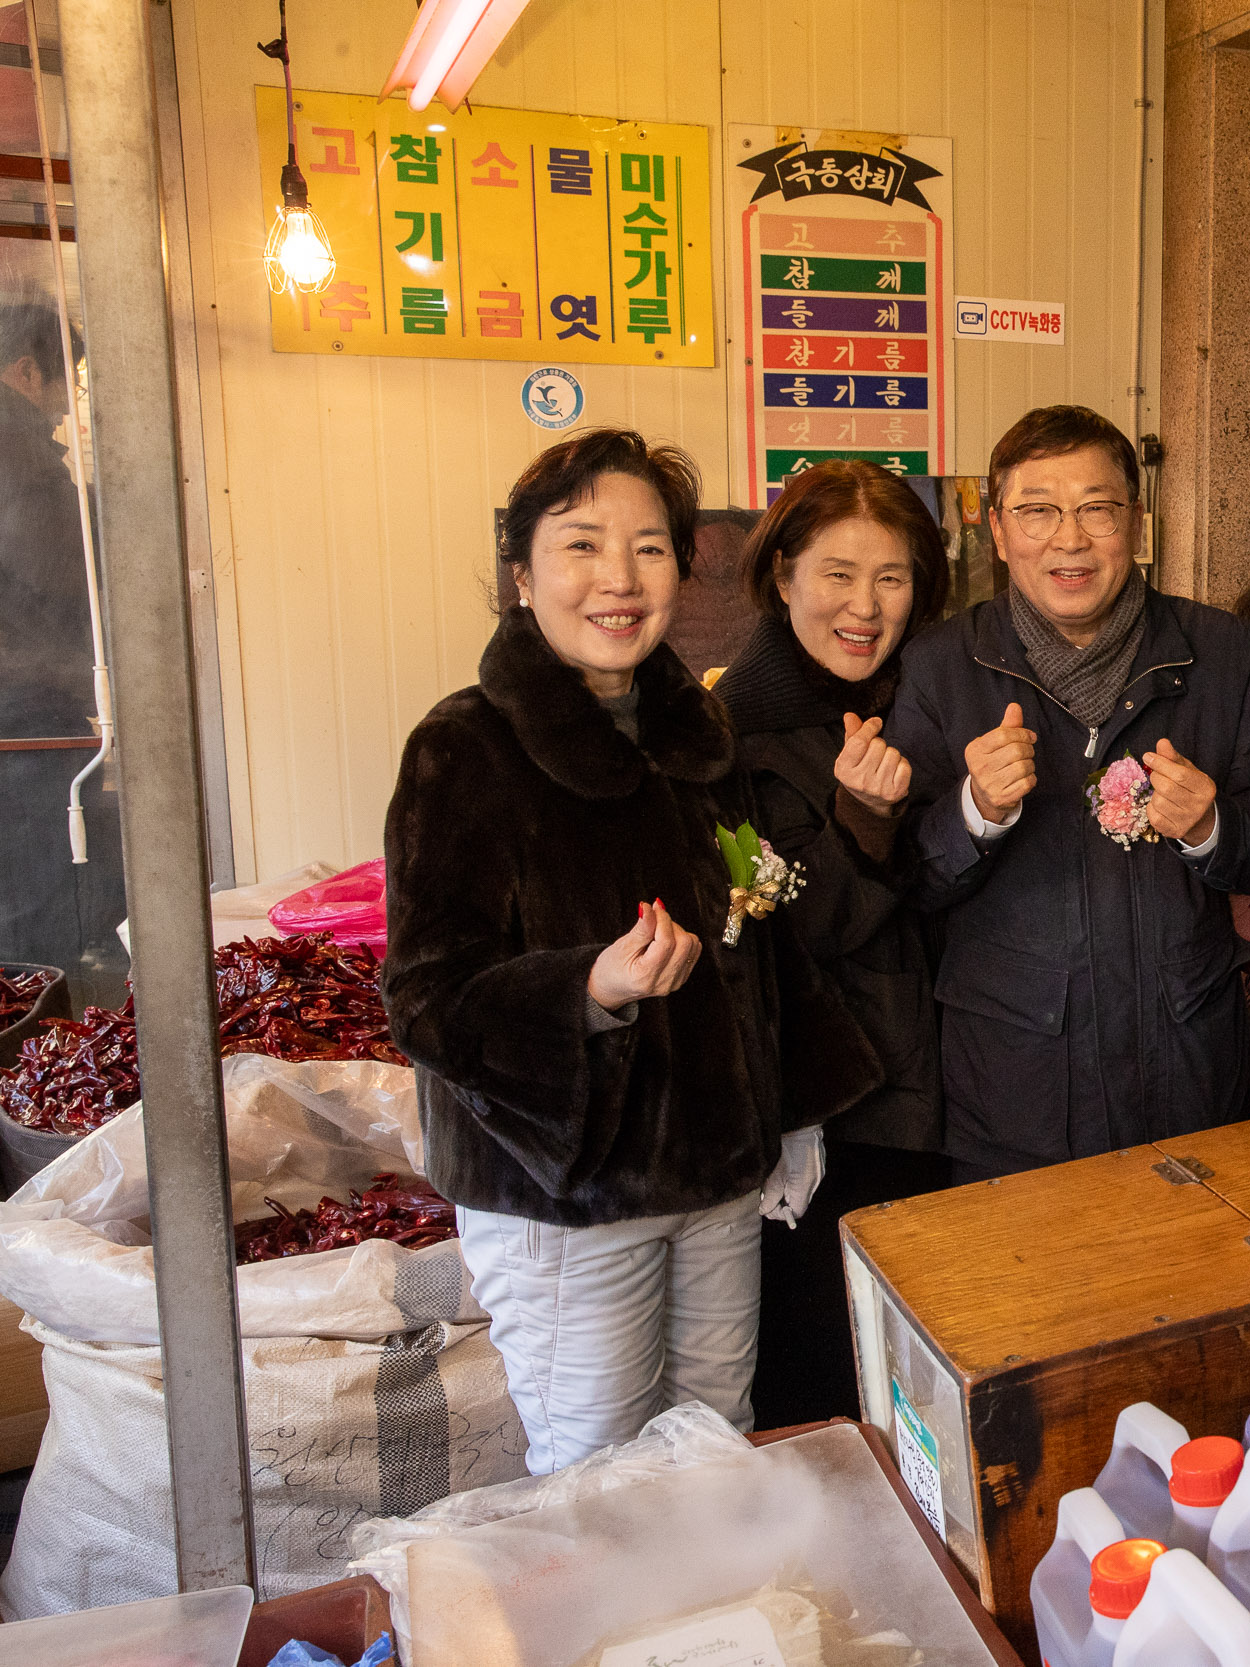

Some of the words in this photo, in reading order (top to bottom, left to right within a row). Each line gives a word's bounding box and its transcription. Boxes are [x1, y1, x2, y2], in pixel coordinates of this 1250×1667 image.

[784, 157, 895, 199] 극동상회
[308, 125, 371, 333] 고추
[389, 133, 449, 336] 참기름
[470, 141, 525, 340] 소금
[546, 146, 602, 343] 물엿
[620, 152, 672, 346] 미수가루
[781, 300, 900, 331] 들깨
[990, 309, 1061, 334] CCTV녹화중
[784, 336, 906, 371] 참기름
[780, 376, 907, 406] 들기름
[787, 415, 909, 444] 엿기름
